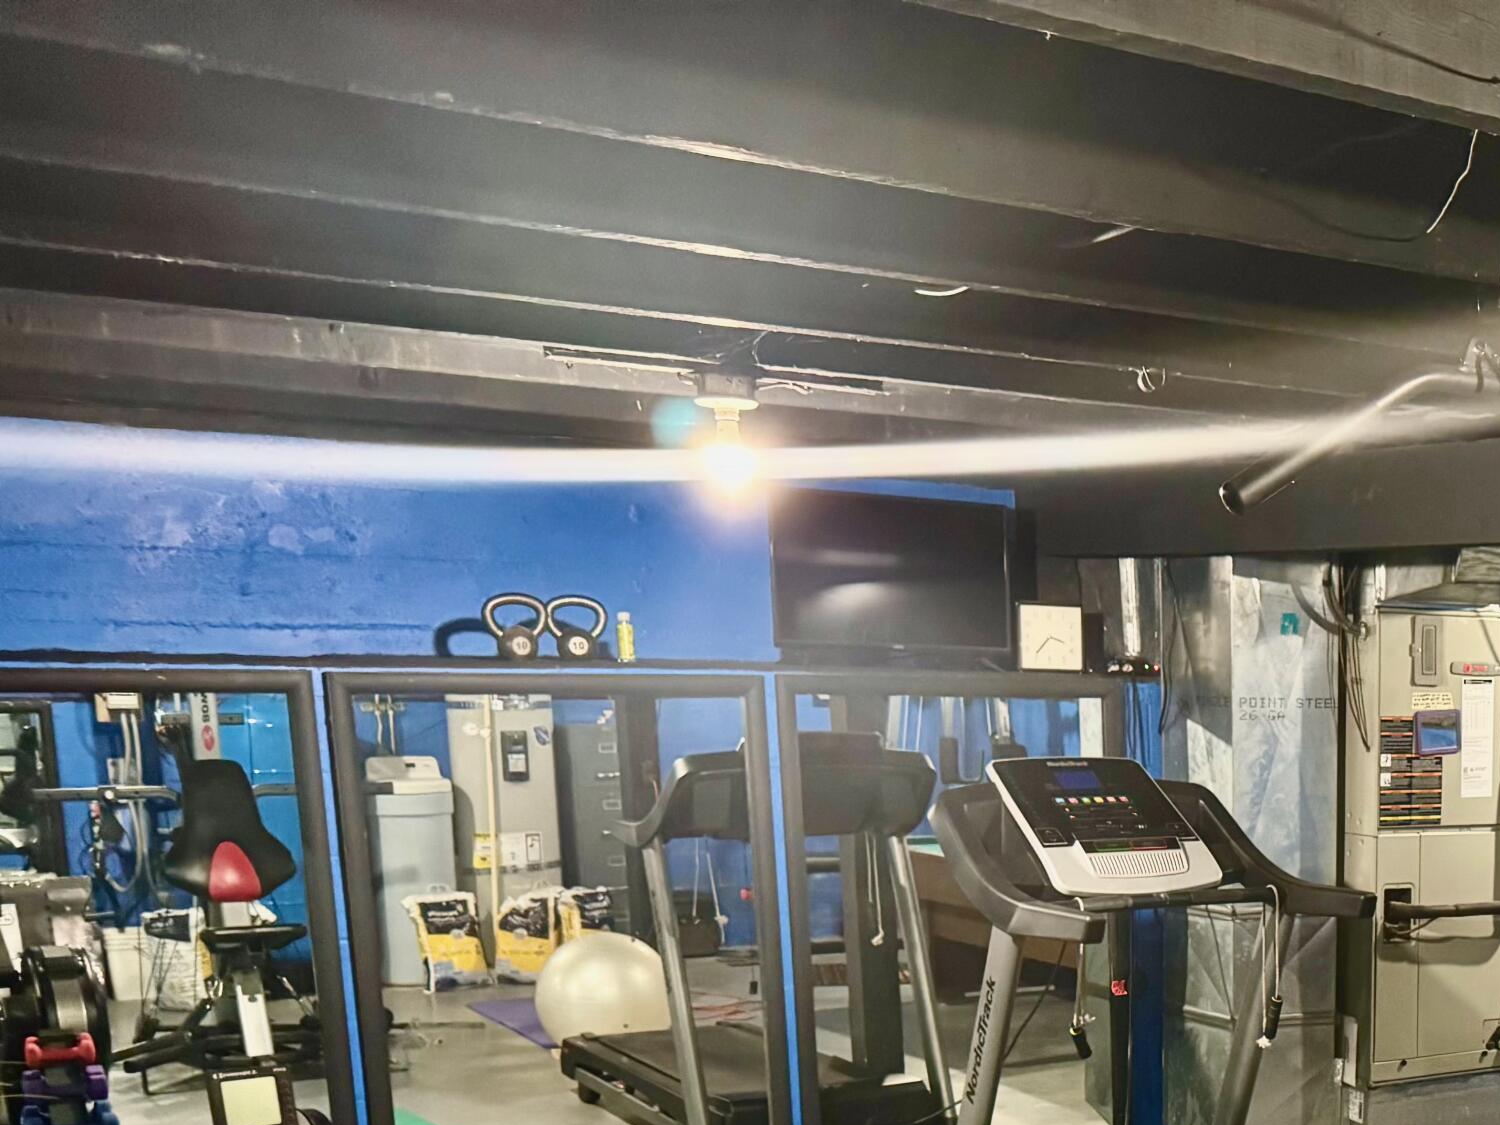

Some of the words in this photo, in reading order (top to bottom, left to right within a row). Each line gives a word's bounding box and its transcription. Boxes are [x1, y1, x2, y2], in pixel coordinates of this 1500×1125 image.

[573, 641, 585, 650] 10
[1239, 697, 1287, 709] POINT
[966, 976, 996, 1105] NordicTrack
